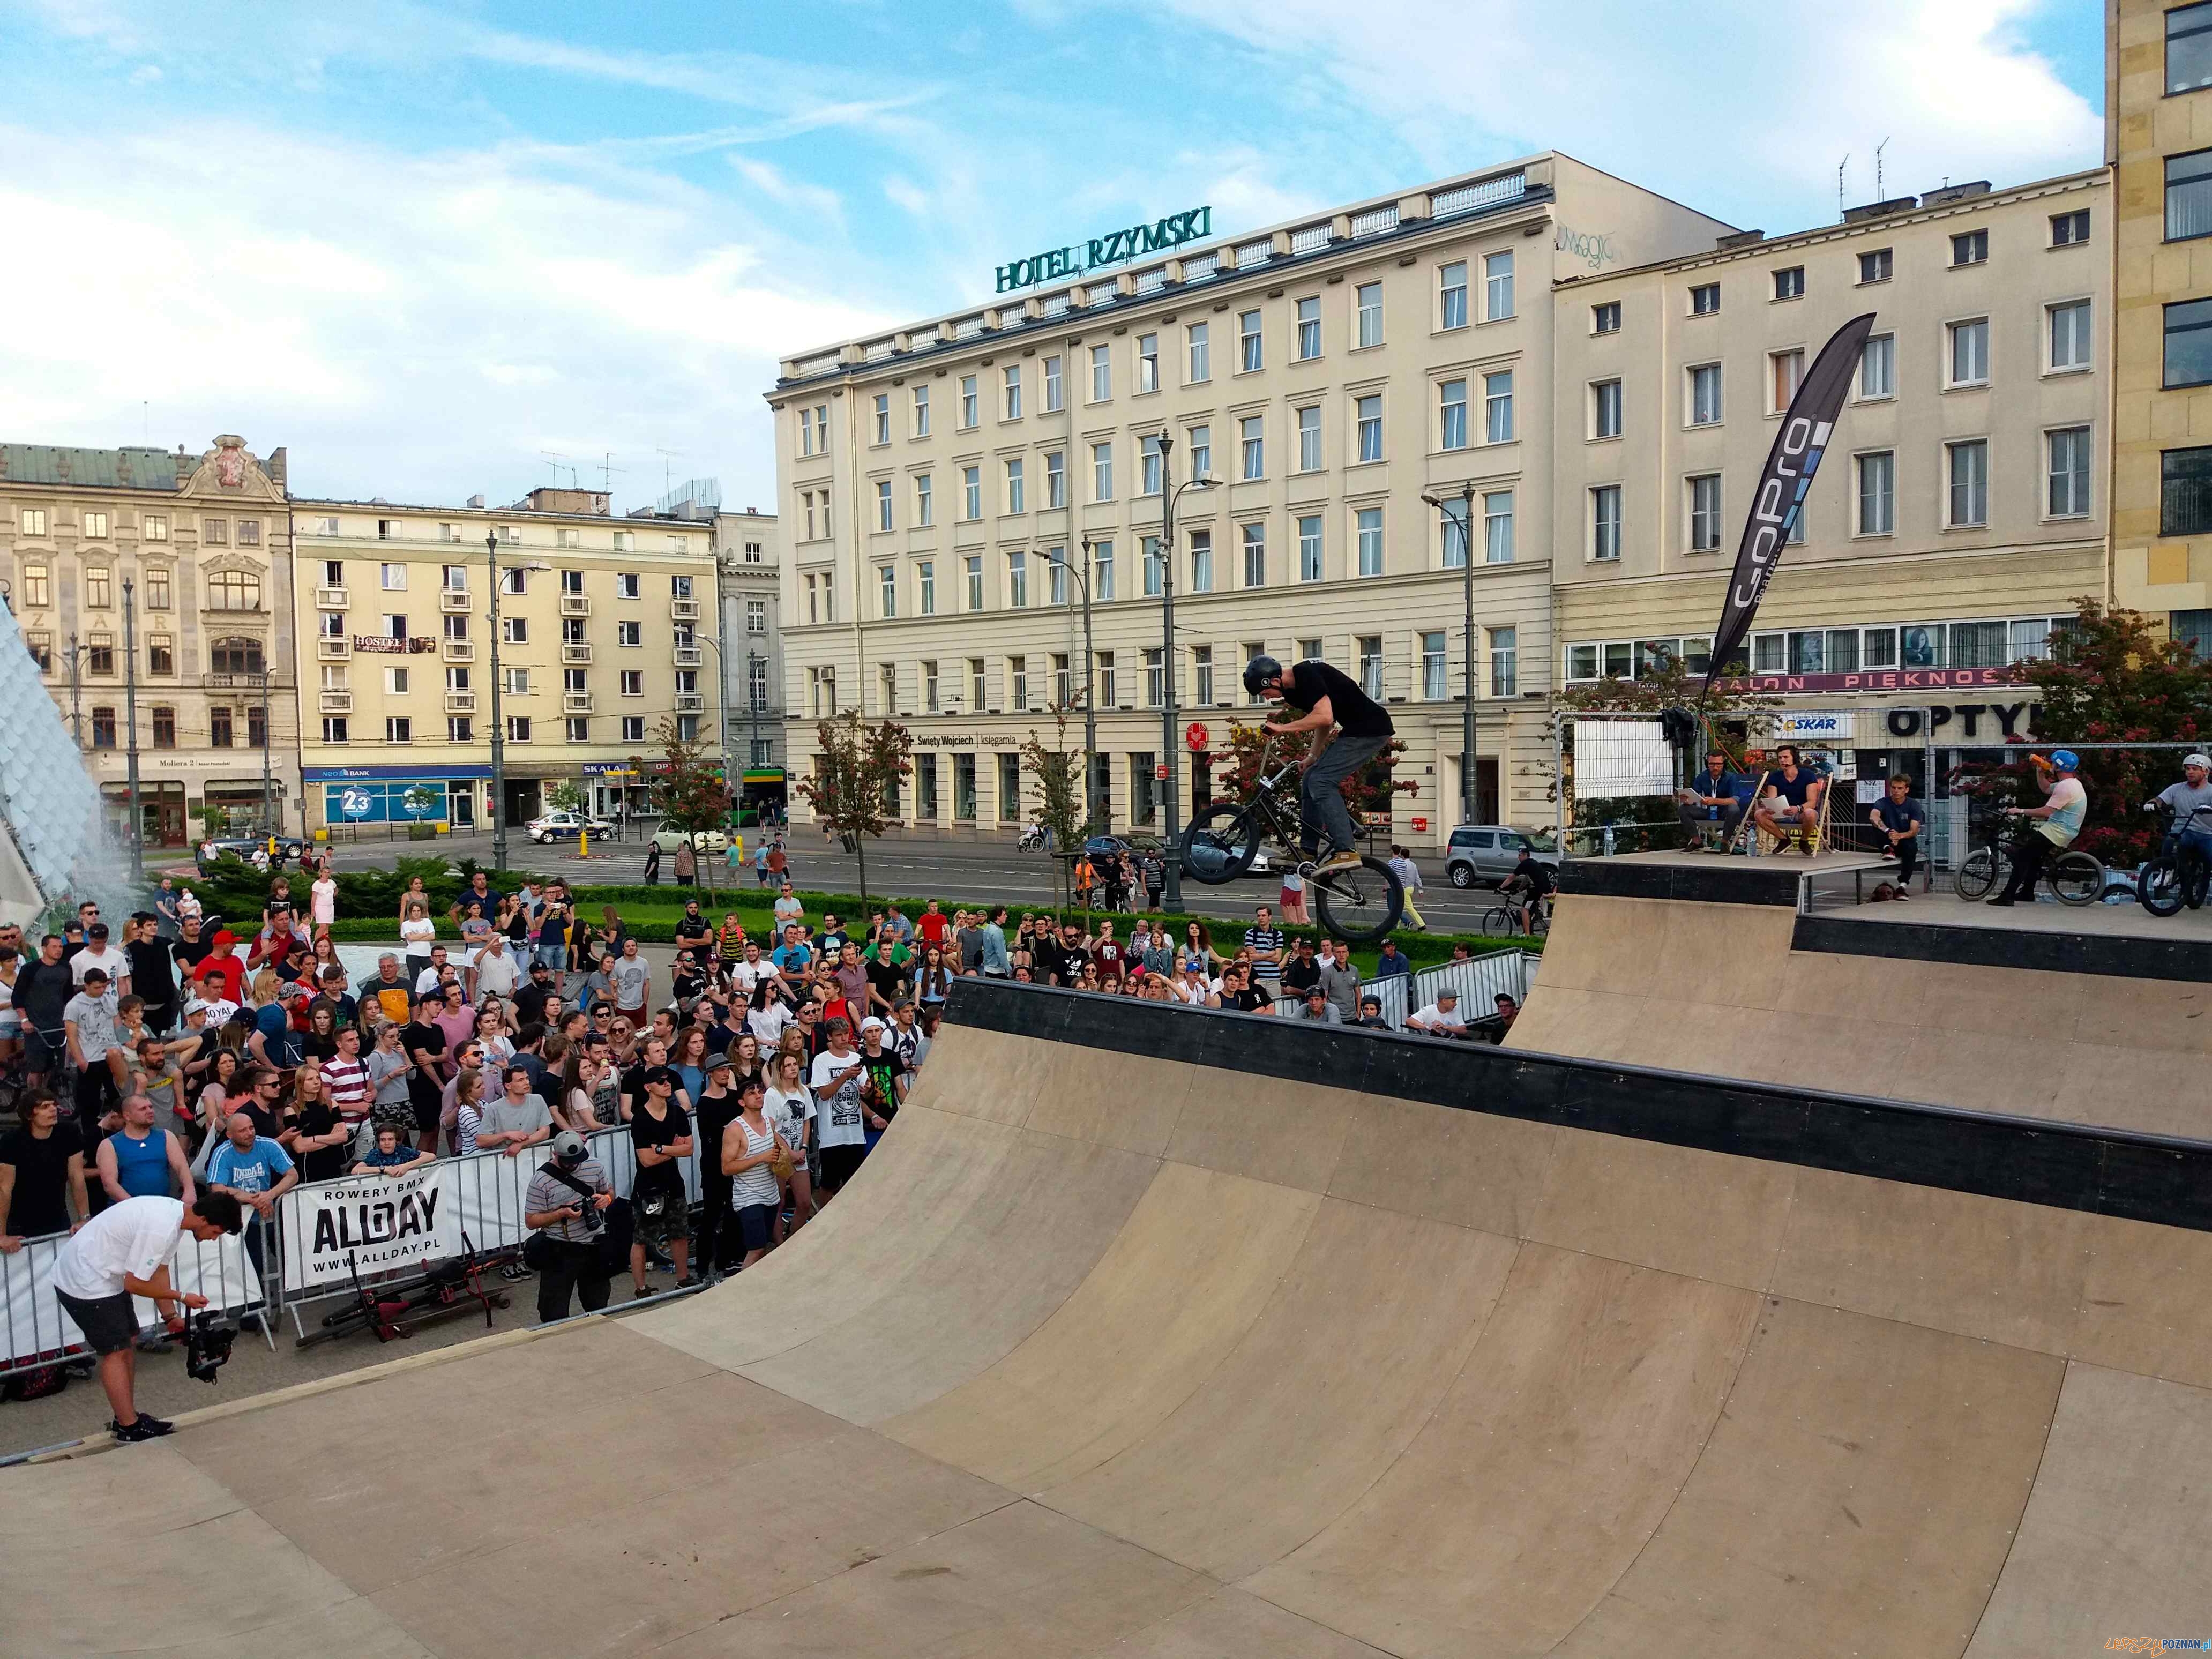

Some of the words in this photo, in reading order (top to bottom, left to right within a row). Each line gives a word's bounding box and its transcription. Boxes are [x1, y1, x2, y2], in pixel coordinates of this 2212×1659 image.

[995, 246, 1079, 293] HOTEL
[1087, 205, 1212, 268] RZYMSKI
[355, 636, 402, 647] HOSTEL
[1783, 719, 1837, 731] OSKAR
[918, 735, 940, 747] Święty
[941, 735, 973, 747] Wojciech
[981, 735, 1016, 746] księgarnia
[325, 1186, 390, 1201] ROWERY
[397, 1176, 425, 1192] BMX
[313, 1187, 439, 1254] ALLDAY
[313, 1239, 440, 1273] WWW.ALLDAY.PL
